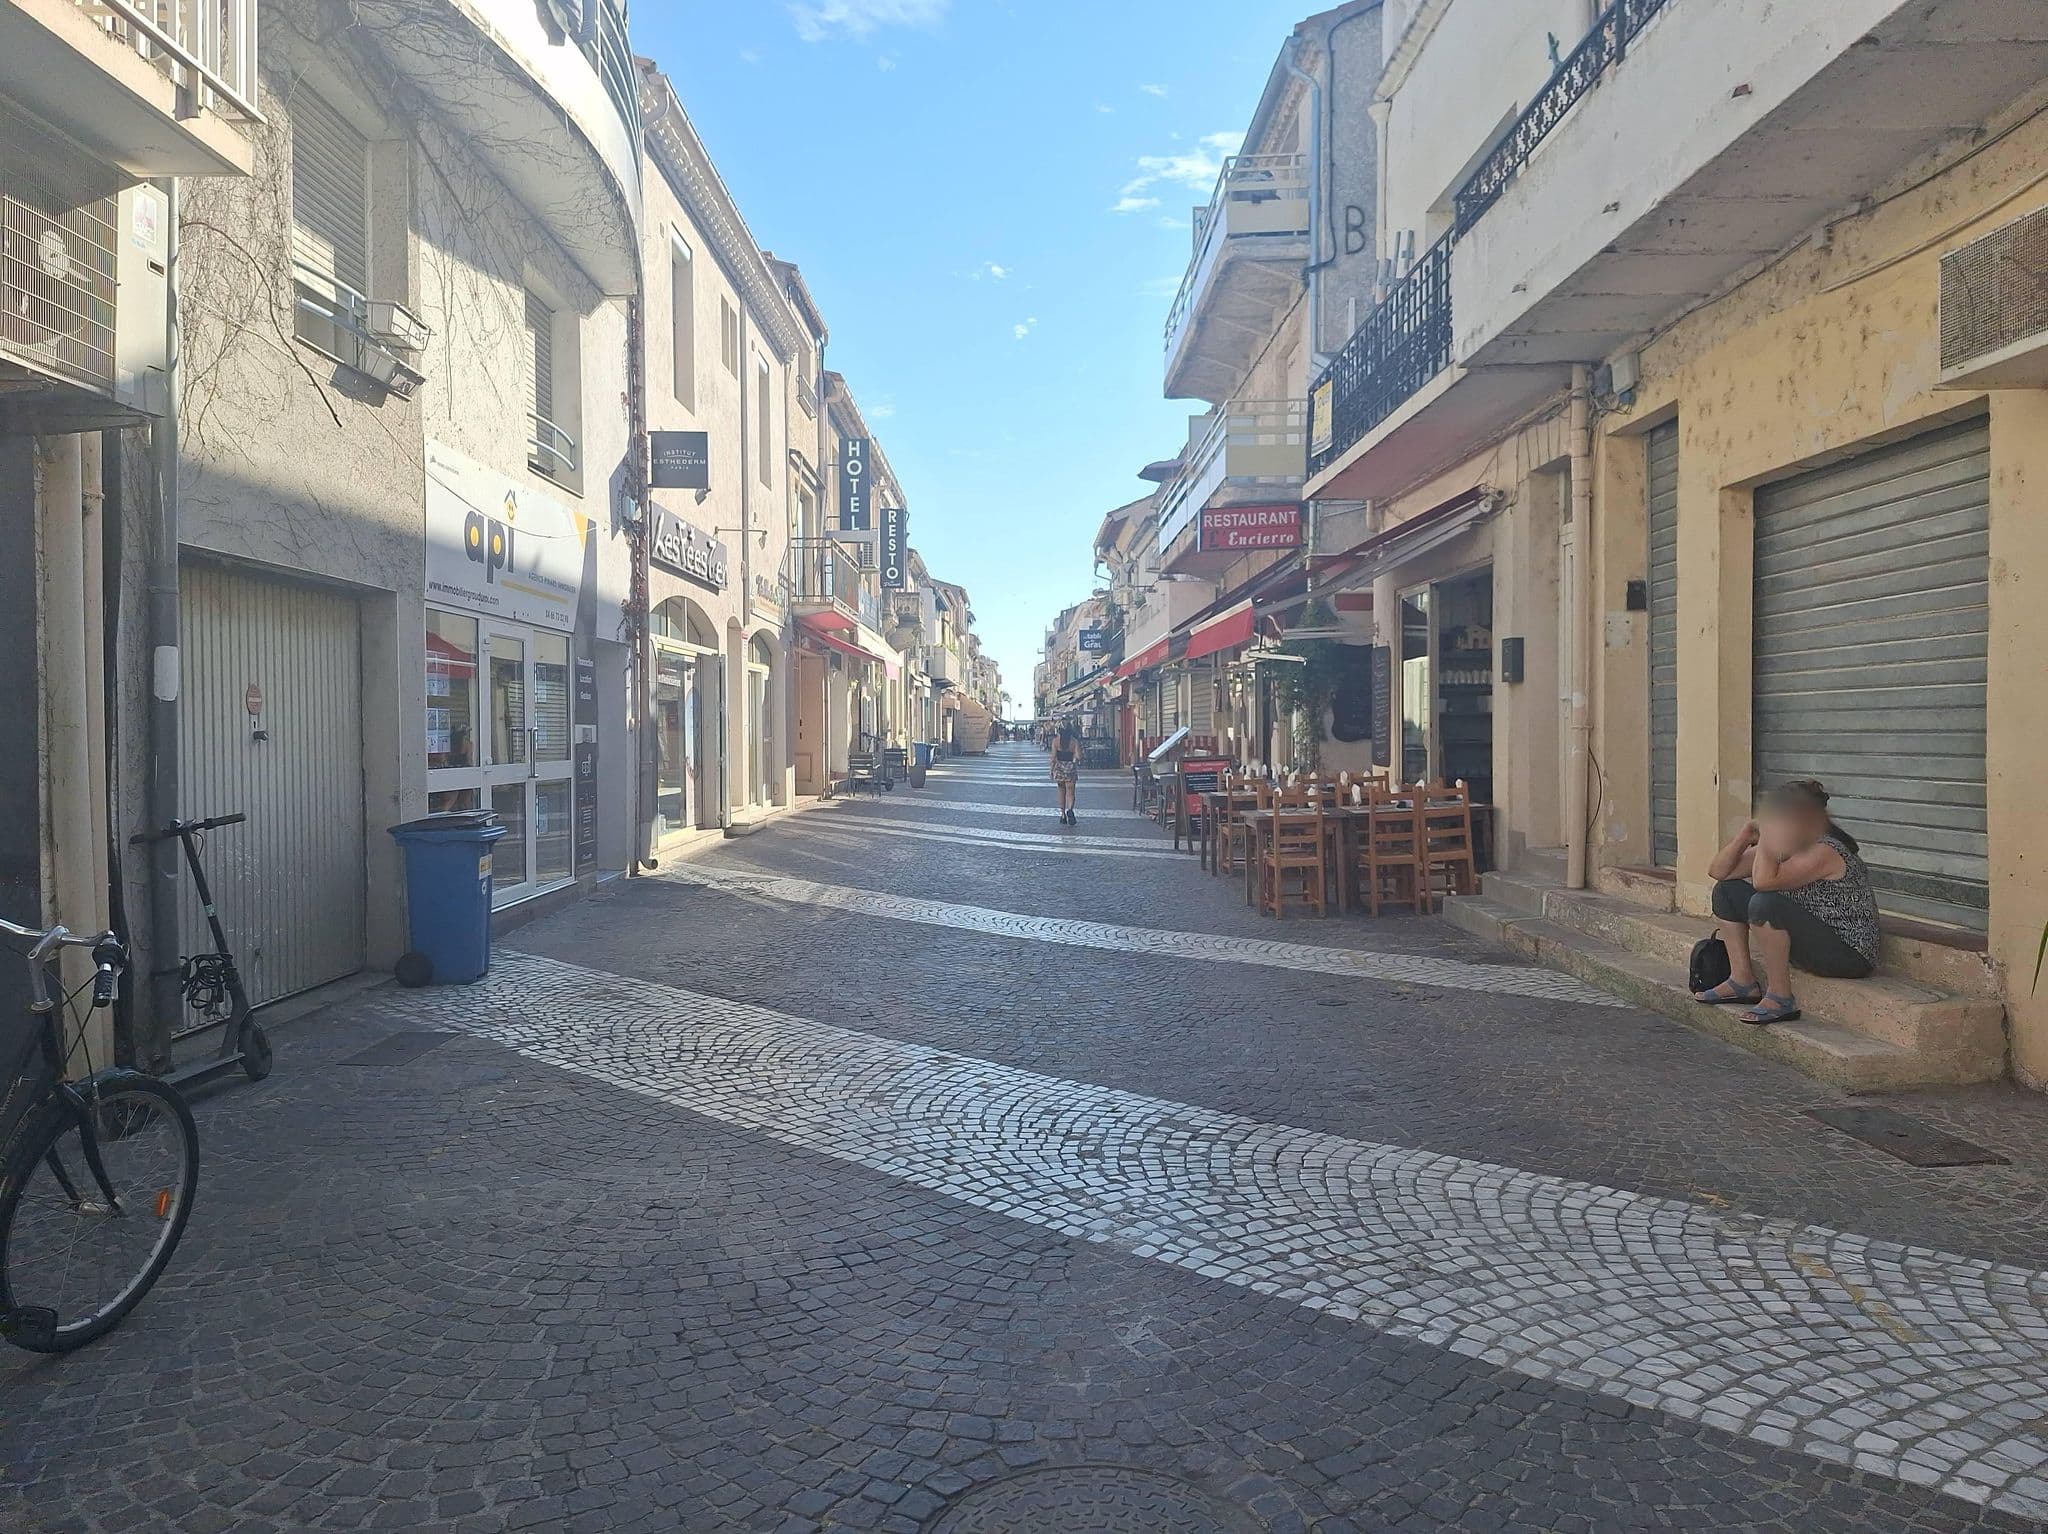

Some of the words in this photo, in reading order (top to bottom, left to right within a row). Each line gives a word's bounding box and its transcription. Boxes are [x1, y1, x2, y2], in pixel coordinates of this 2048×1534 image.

[1345, 205, 1366, 255] B
[663, 449, 697, 457] INSTITUT
[846, 440, 863, 531] HOTEL
[655, 511, 680, 563] Les
[886, 510, 899, 579] RESTO
[1203, 510, 1297, 528] RESTAURANT
